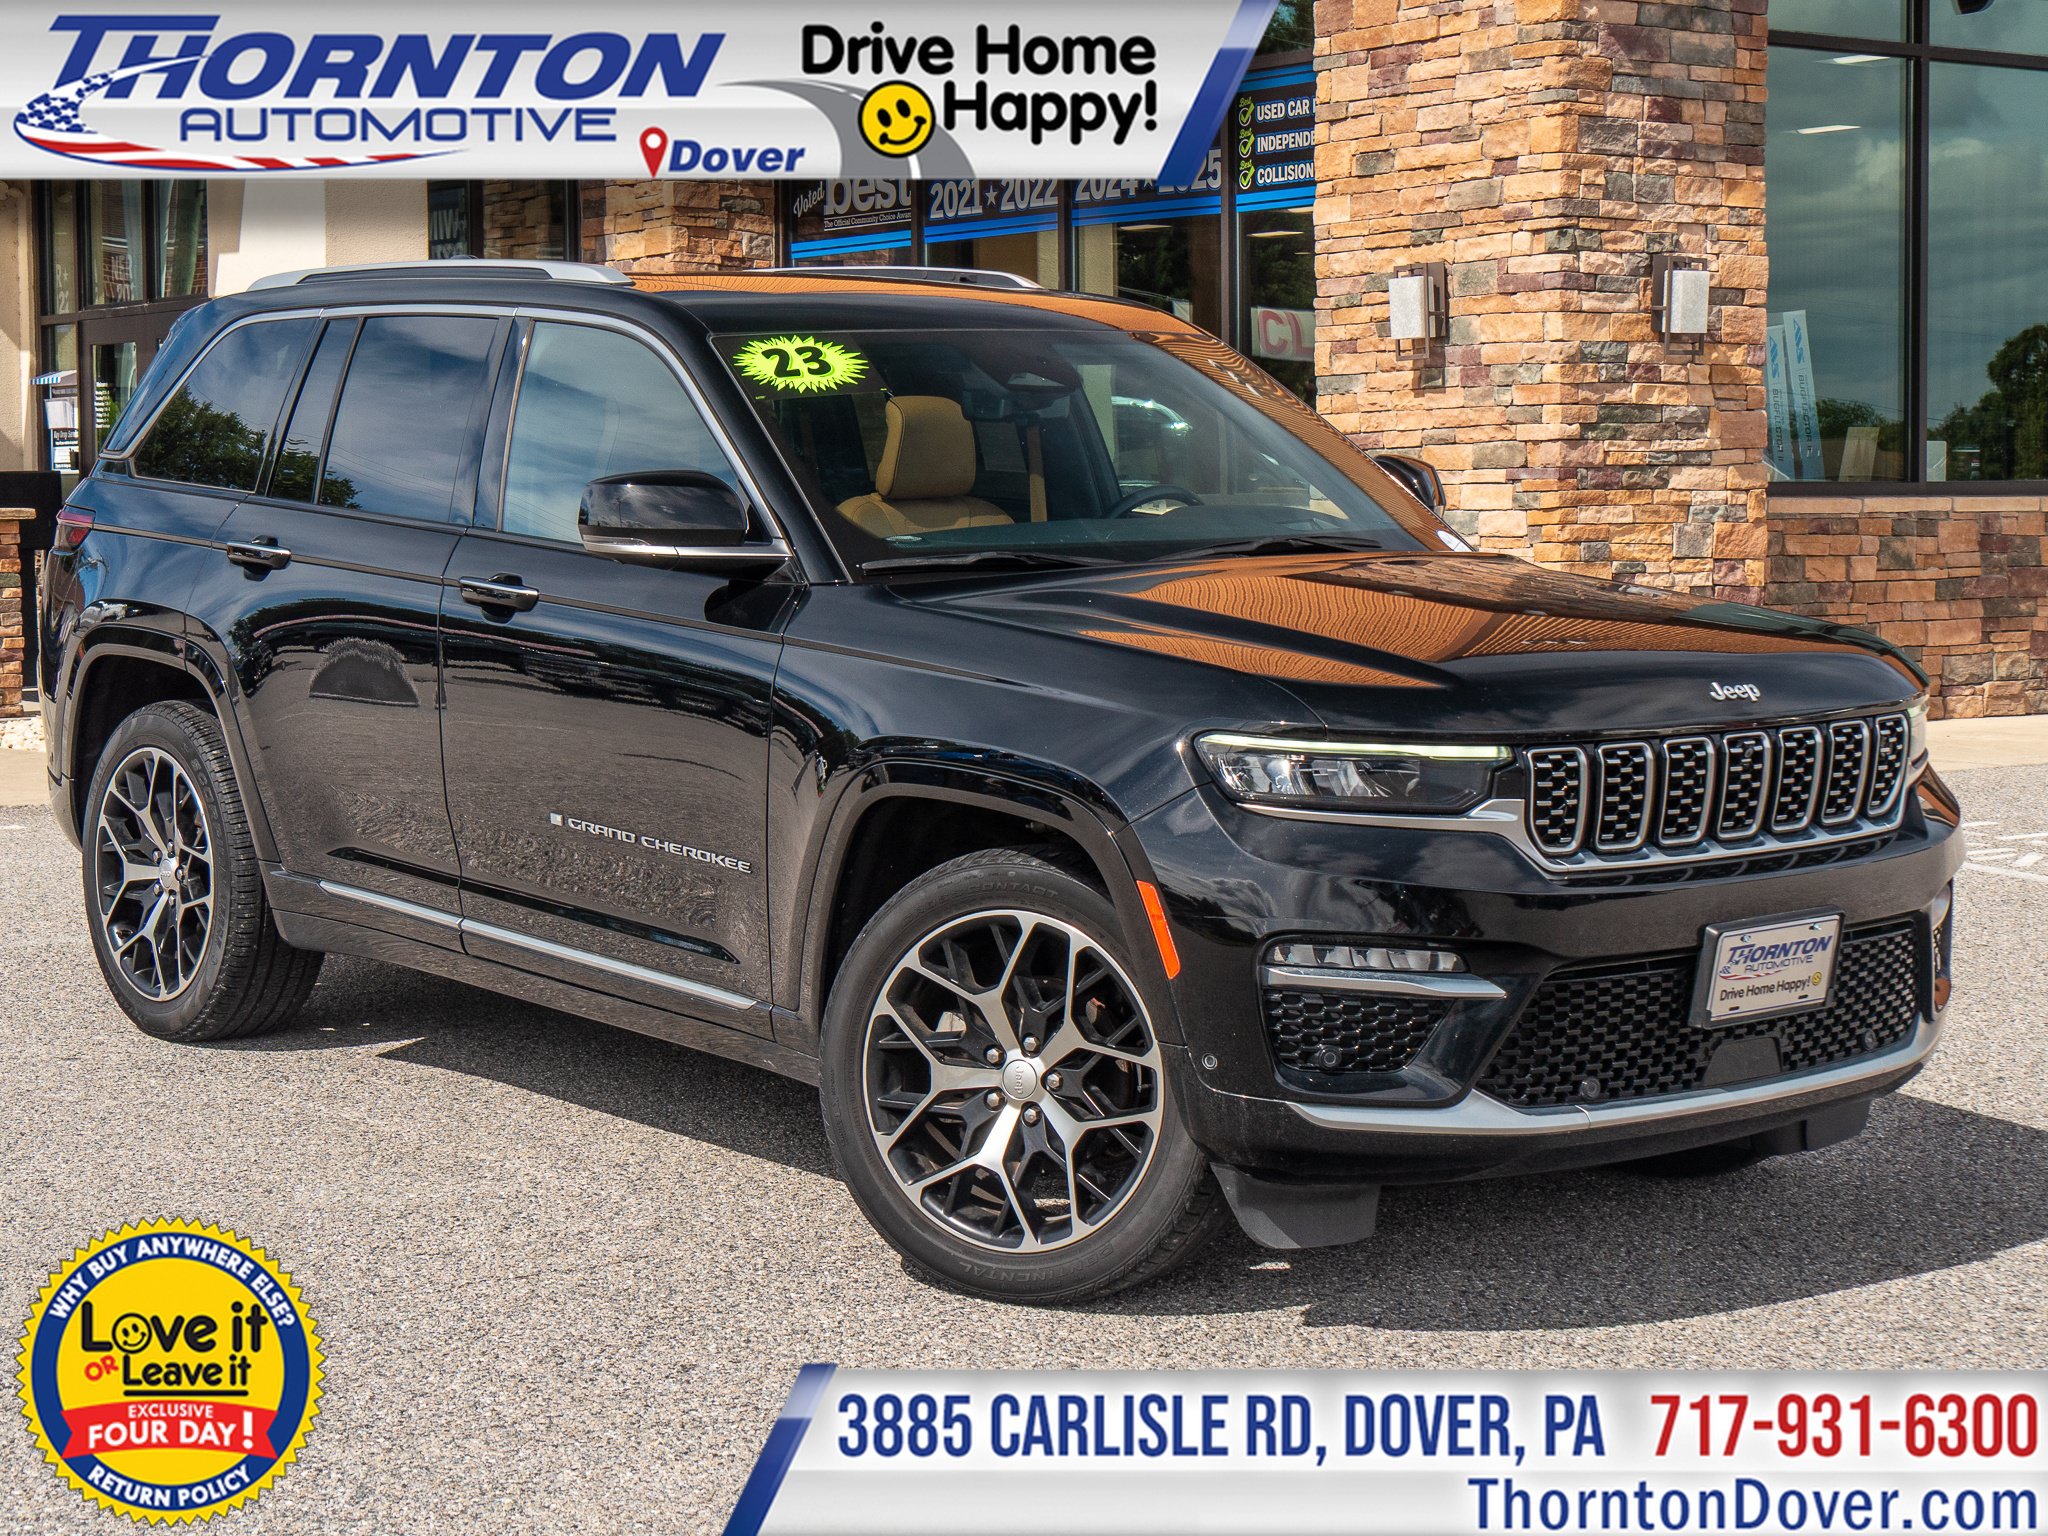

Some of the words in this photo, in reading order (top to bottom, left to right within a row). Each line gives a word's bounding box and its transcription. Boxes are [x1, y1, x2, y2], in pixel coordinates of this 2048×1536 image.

[1257, 103, 1285, 120] USED
[1288, 99, 1310, 116] CAR
[1257, 163, 1314, 183] COLLISION
[793, 181, 825, 217] Voted
[930, 179, 982, 219] 2021
[1000, 178, 1058, 211] 2022
[824, 221, 833, 229] The
[761, 346, 833, 378] 23
[1710, 682, 1760, 701] Jeep
[568, 817, 636, 844] GRAND
[641, 836, 752, 874] CHEROKEE
[1727, 935, 1833, 966] THORNTON
[1744, 955, 1813, 973] AUTOMOTIVE
[1720, 987, 1745, 1001] Drive
[1747, 982, 1775, 997] Home
[1777, 975, 1811, 994] Happy!
